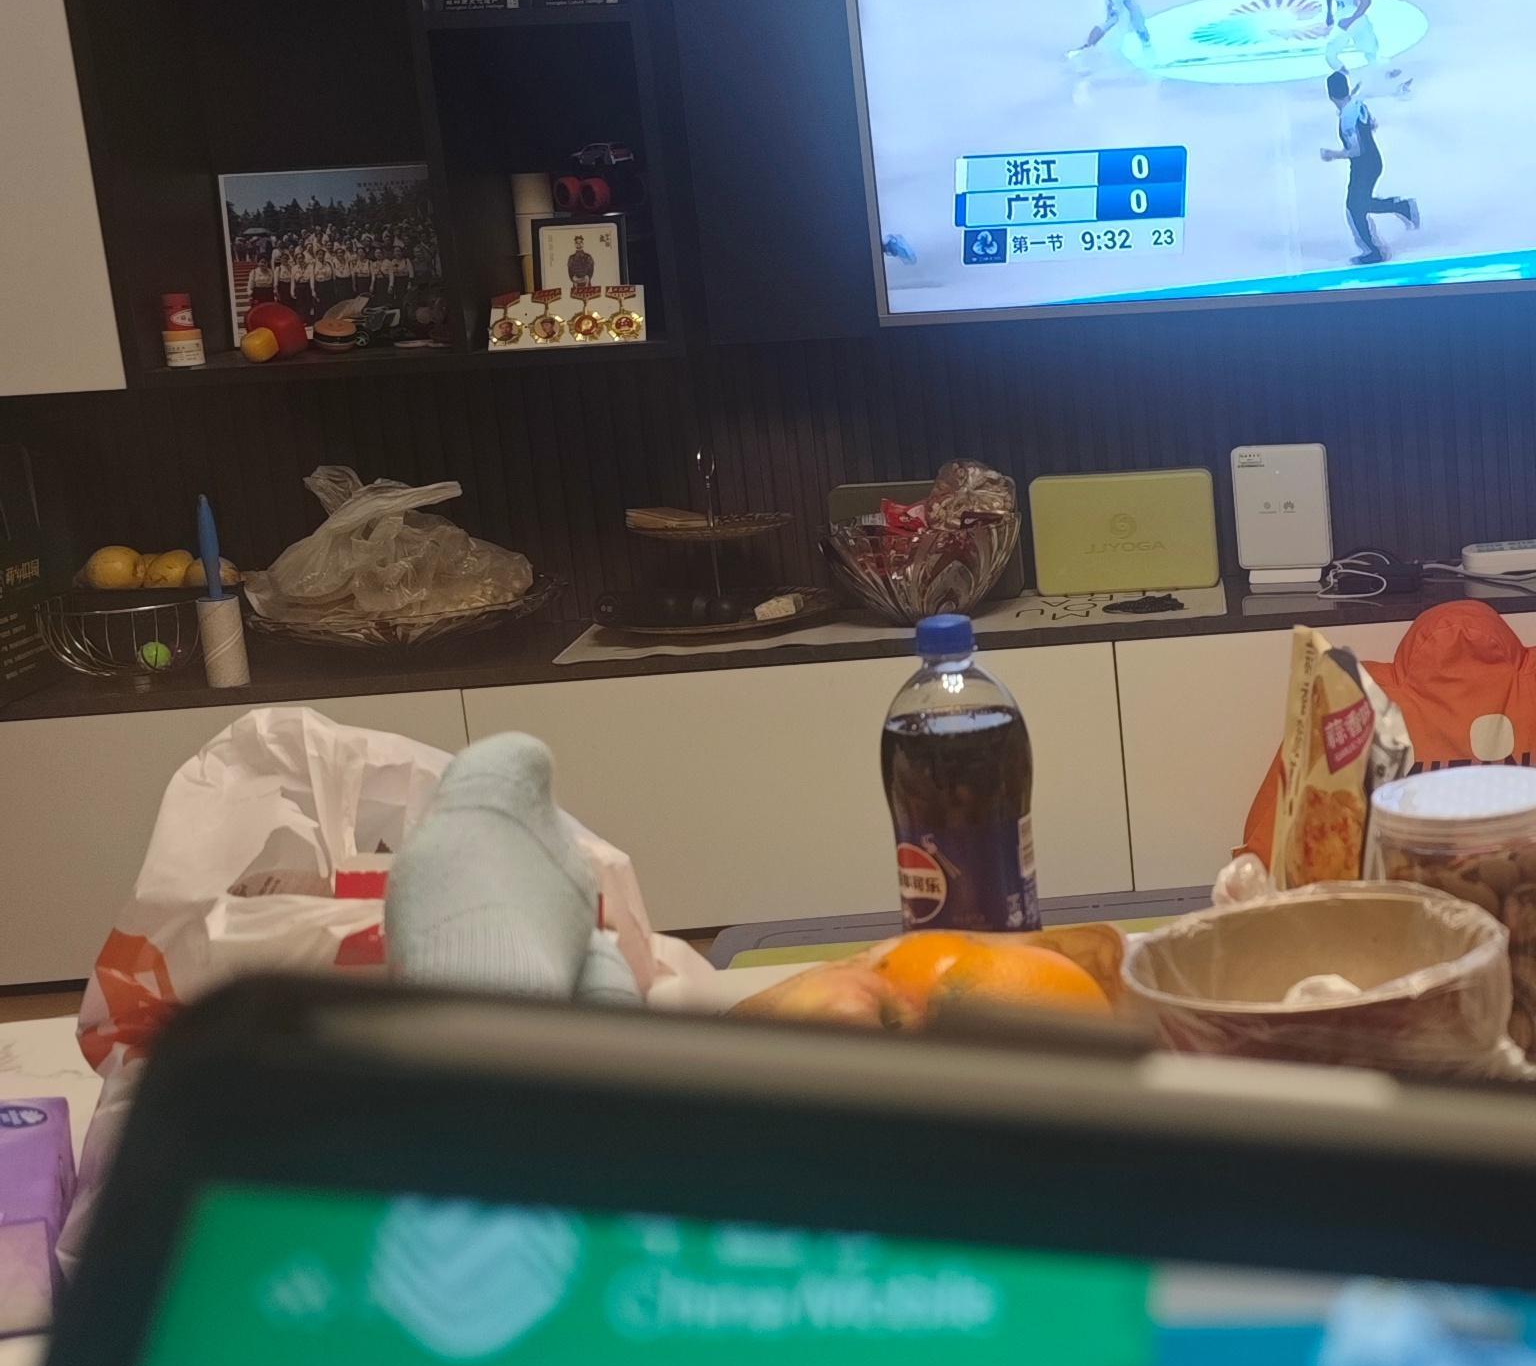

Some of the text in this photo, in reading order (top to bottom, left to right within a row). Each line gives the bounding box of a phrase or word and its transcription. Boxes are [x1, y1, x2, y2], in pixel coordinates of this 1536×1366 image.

[1006, 154, 1149, 187] 浙江 0
[1006, 189, 1147, 220] 广东 0
[1012, 228, 1175, 254] 第一节 9:32 23
[899, 874, 941, 894] 事可乐
